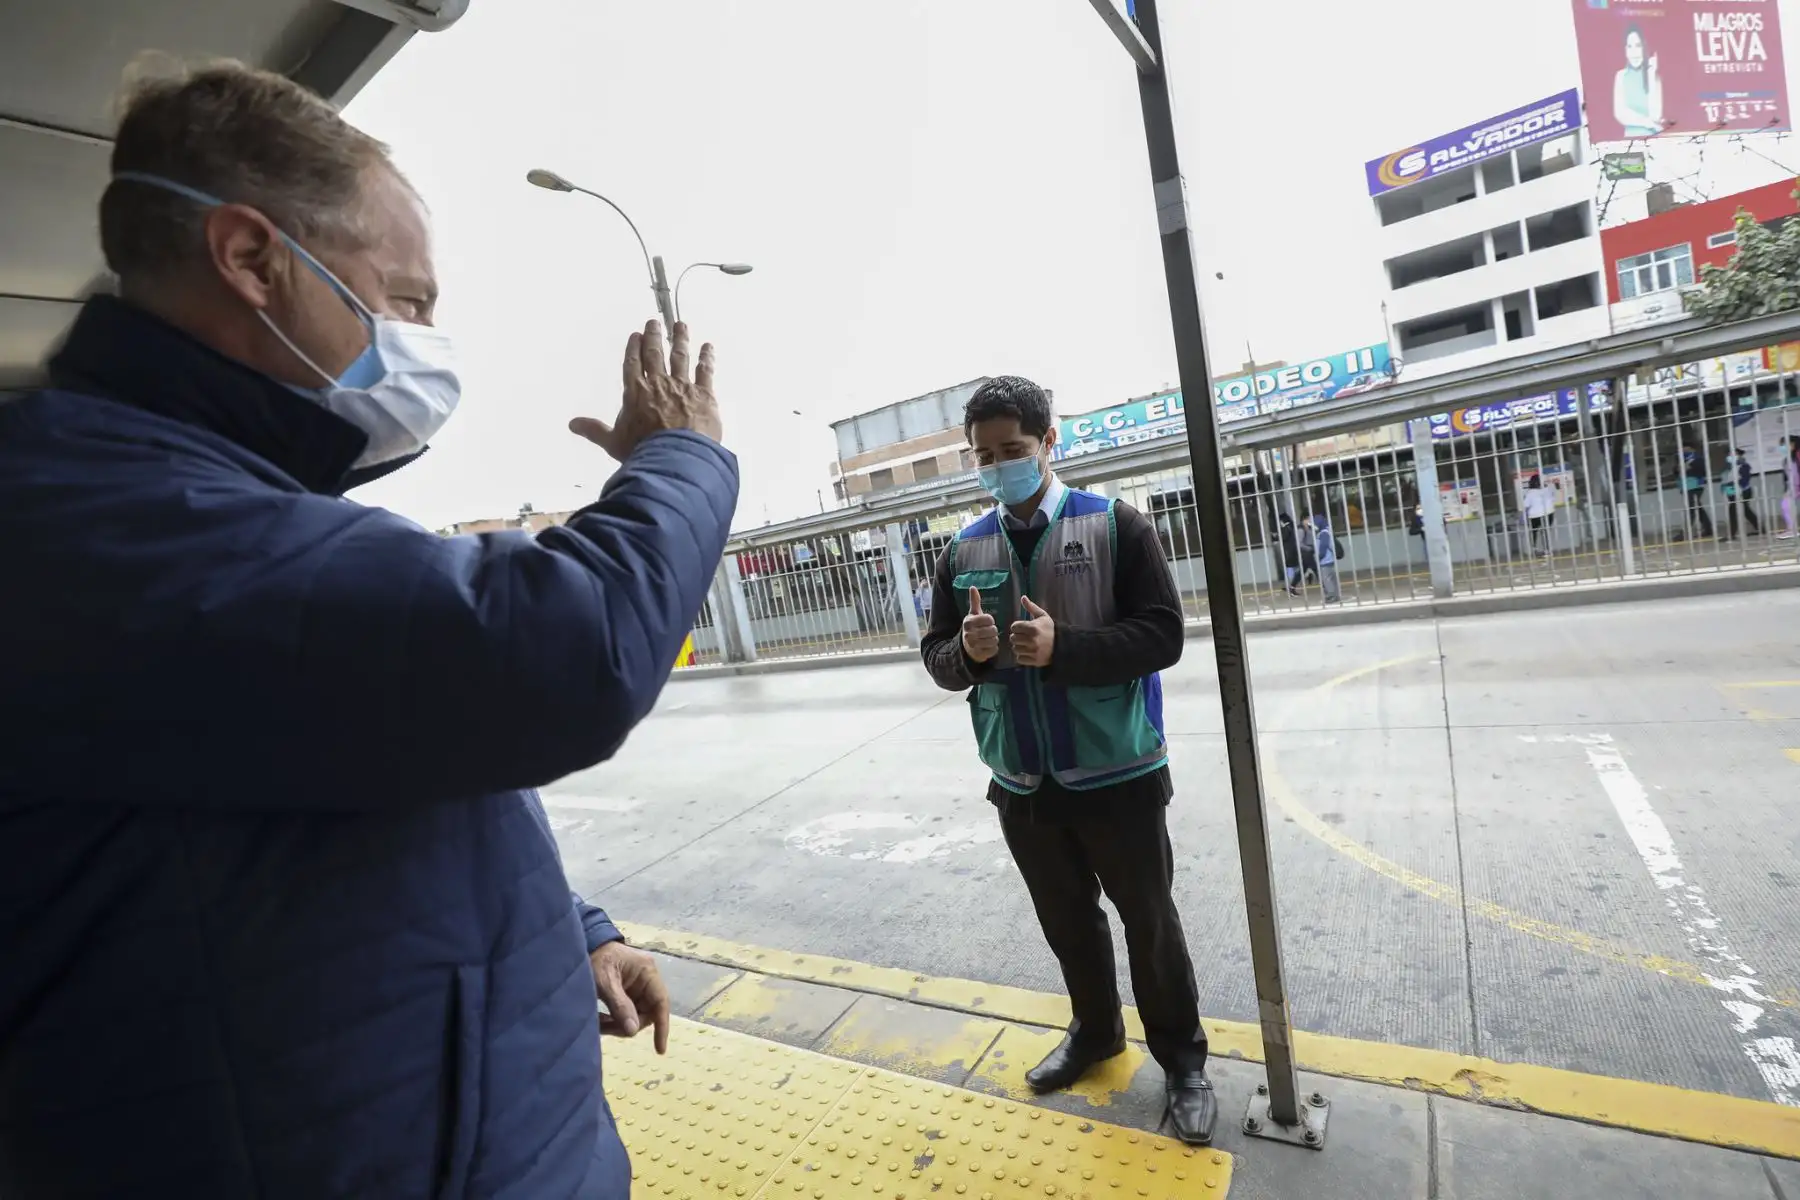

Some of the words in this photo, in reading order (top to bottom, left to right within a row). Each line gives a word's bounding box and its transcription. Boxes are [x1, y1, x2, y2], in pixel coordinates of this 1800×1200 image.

[1693, 12, 1763, 32] MILAGROS
[1696, 31, 1768, 62] LEIVA
[1704, 62, 1763, 74] ENTREVISTA
[1145, 397, 1184, 421] EL
